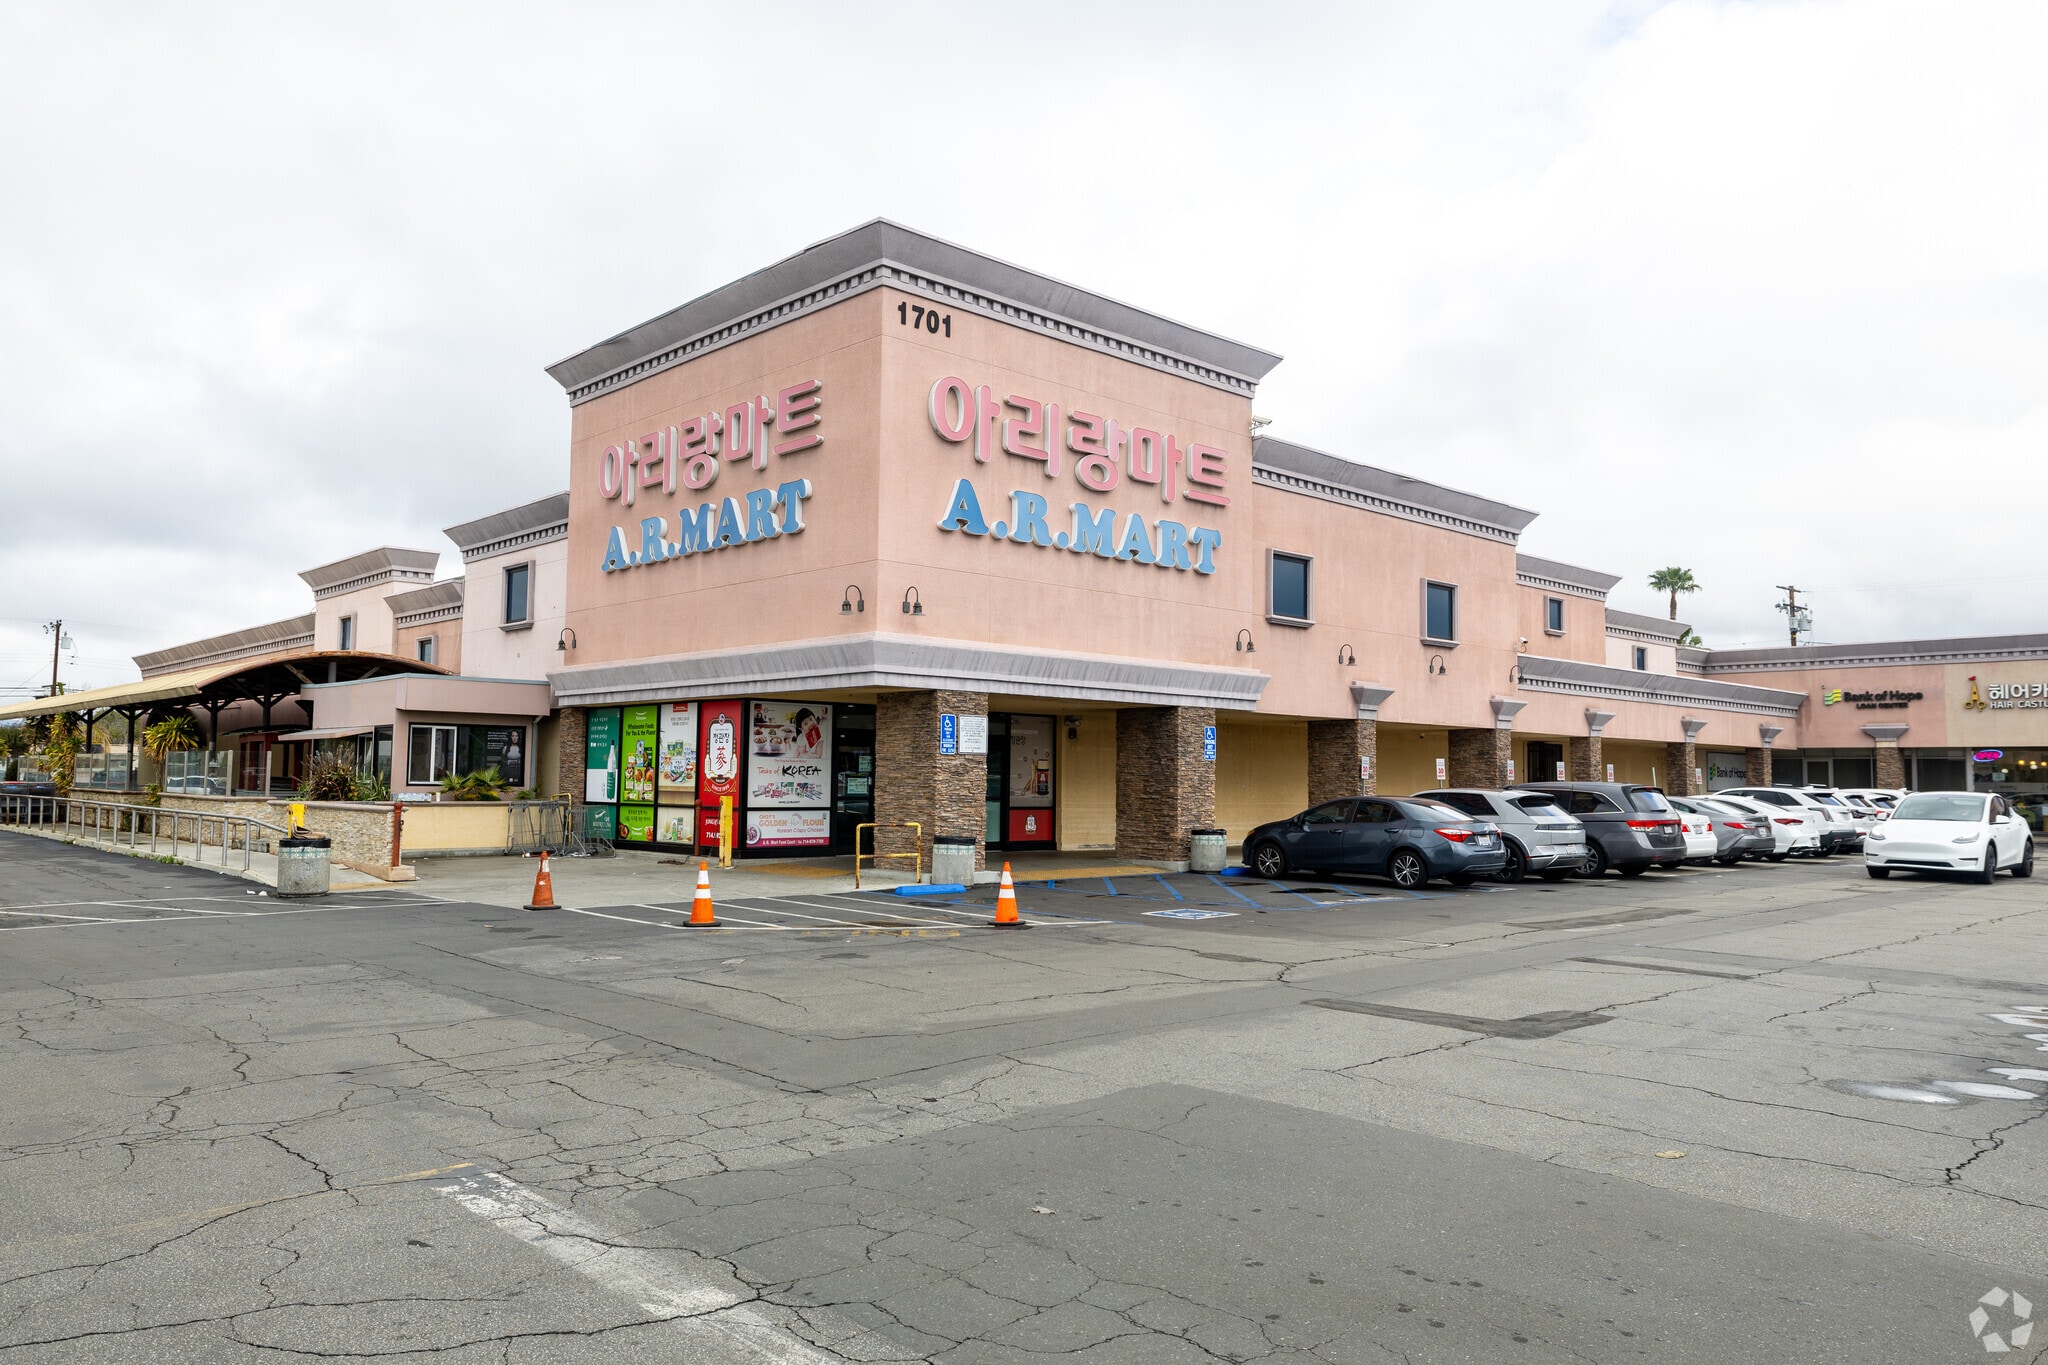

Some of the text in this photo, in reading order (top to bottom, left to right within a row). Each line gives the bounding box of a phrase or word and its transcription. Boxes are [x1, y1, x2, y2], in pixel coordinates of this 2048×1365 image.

[898, 301, 951, 338] 1701
[599, 379, 824, 507] 아리랑마트
[928, 376, 1231, 506] 아리랑마트
[601, 478, 813, 573] A.R.MART
[937, 479, 1222, 574] A.R.MART
[1843, 690, 1923, 702] Bank of Hope
[712, 733, 730, 743] 정관장
[1976, 752, 1999, 760] OPEN
[774, 766, 780, 776] of
[782, 765, 822, 779] KOREA
[1717, 766, 1728, 778] Bank
